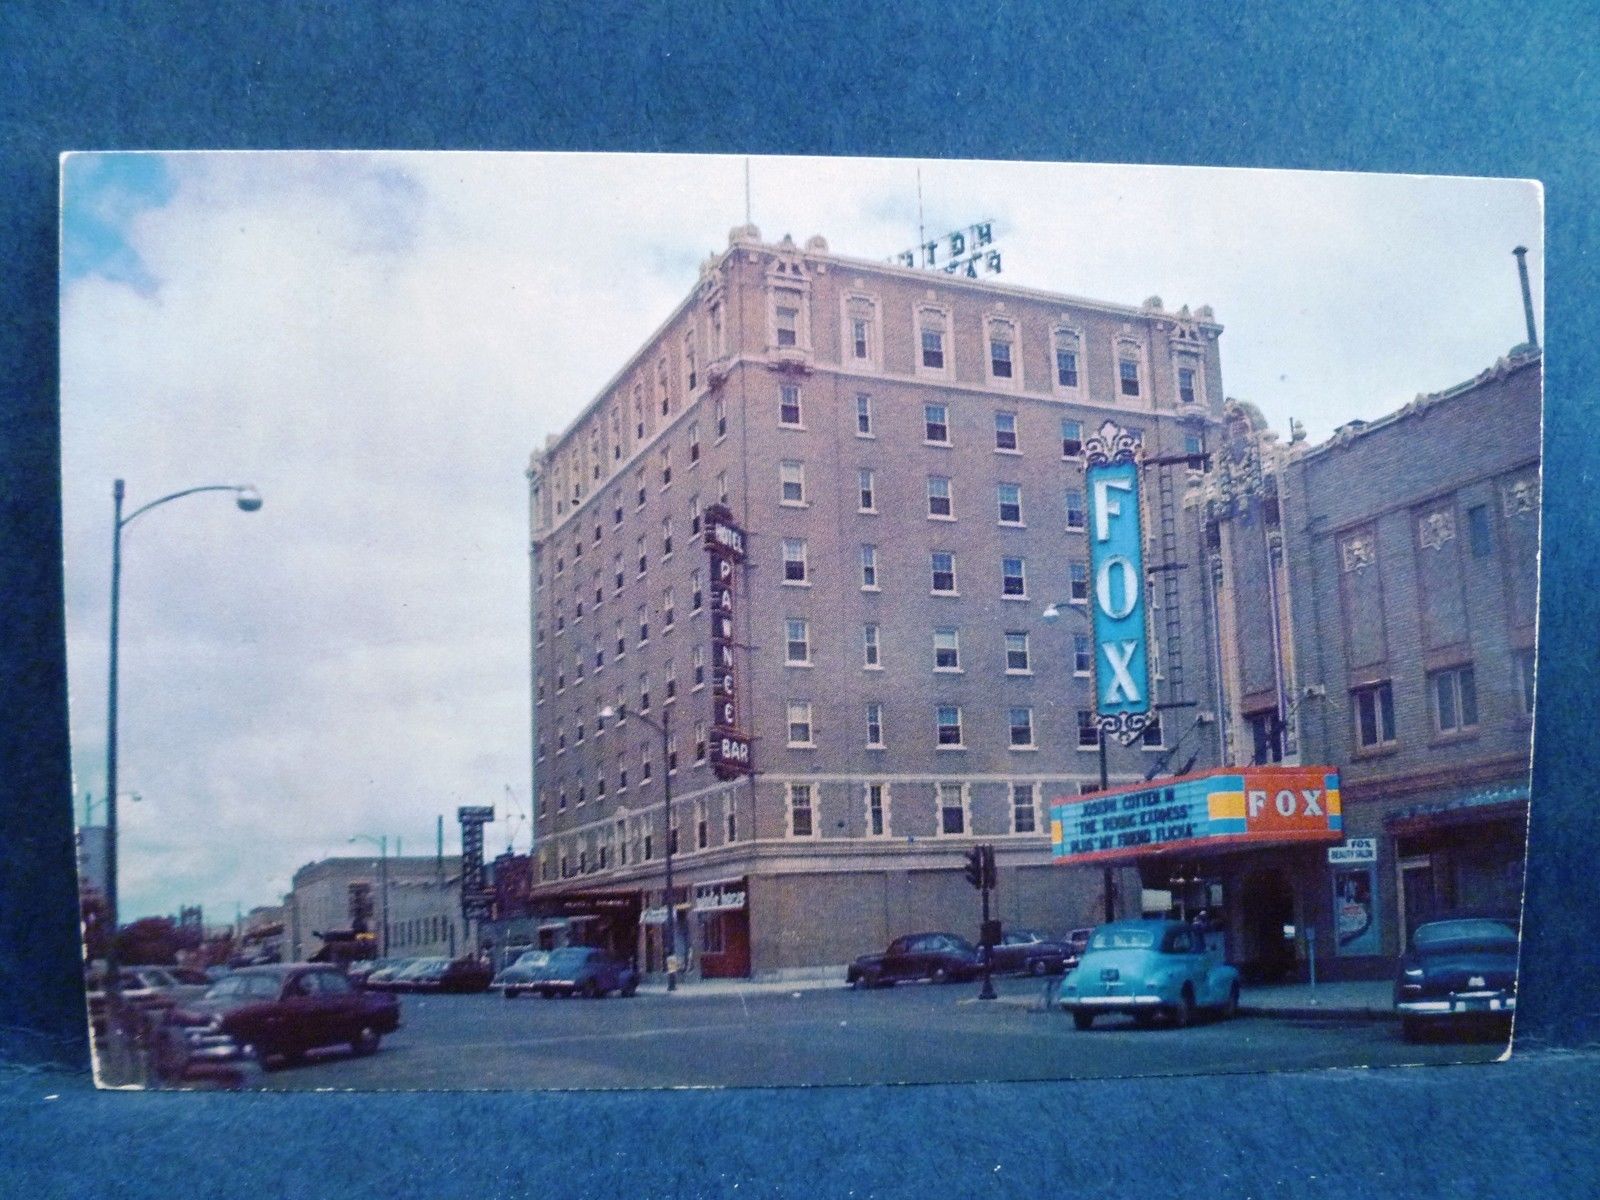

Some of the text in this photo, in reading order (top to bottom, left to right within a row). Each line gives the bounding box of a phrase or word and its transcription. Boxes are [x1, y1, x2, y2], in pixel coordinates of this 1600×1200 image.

[1094, 477, 1142, 706] FOX
[721, 738, 749, 763] BAR
[1249, 789, 1324, 818] FOX
[1351, 840, 1371, 849] FOX
